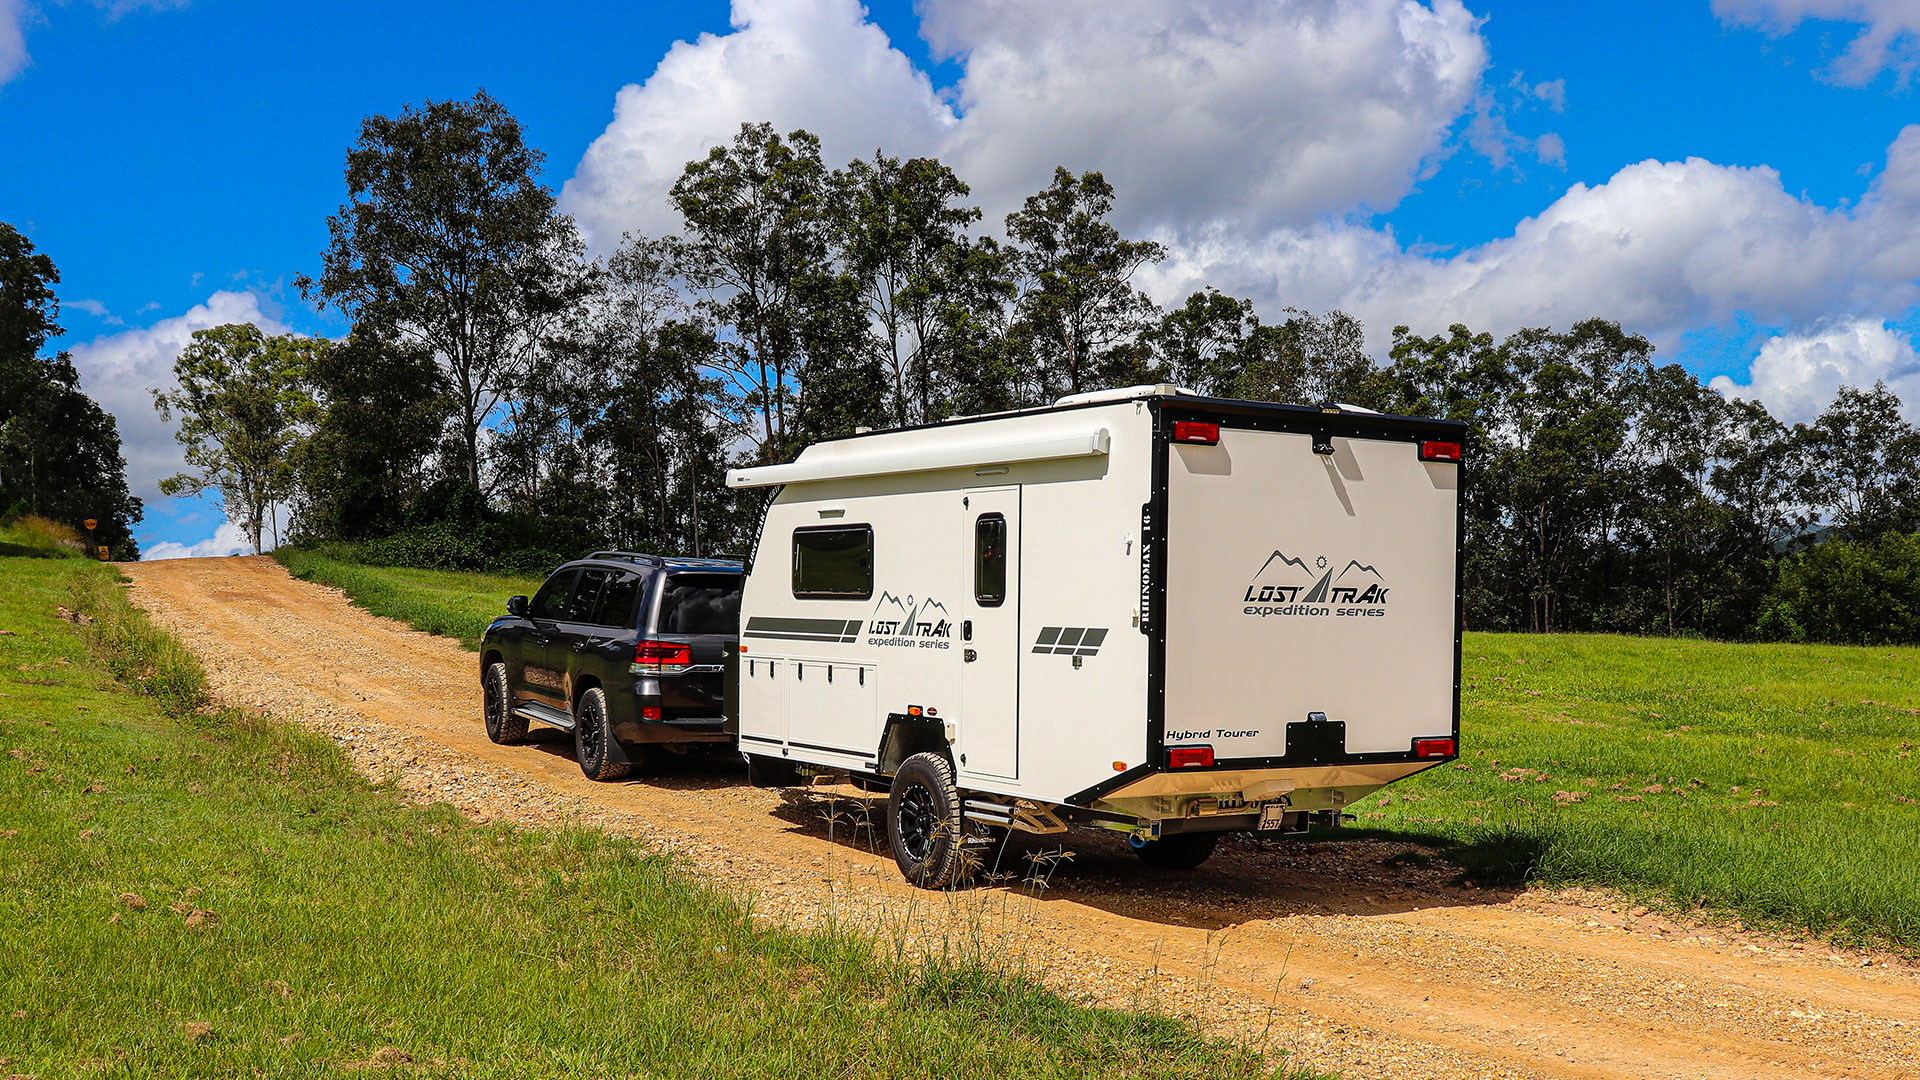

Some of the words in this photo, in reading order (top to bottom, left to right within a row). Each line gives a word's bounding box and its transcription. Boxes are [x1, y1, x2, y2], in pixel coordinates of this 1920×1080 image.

[1143, 515, 1151, 531] 16
[1141, 544, 1151, 622] RHINOMAX
[1243, 586, 1304, 602] LOST
[1331, 583, 1390, 604] TRAK
[1243, 605, 1330, 617] expedition
[1336, 607, 1385, 617] series
[868, 620, 901, 635] LOST
[916, 619, 952, 637] TRAK
[868, 637, 915, 647] expedition
[919, 639, 950, 649] series
[1166, 730, 1211, 741] Hybrid
[1216, 729, 1259, 738] Tourer
